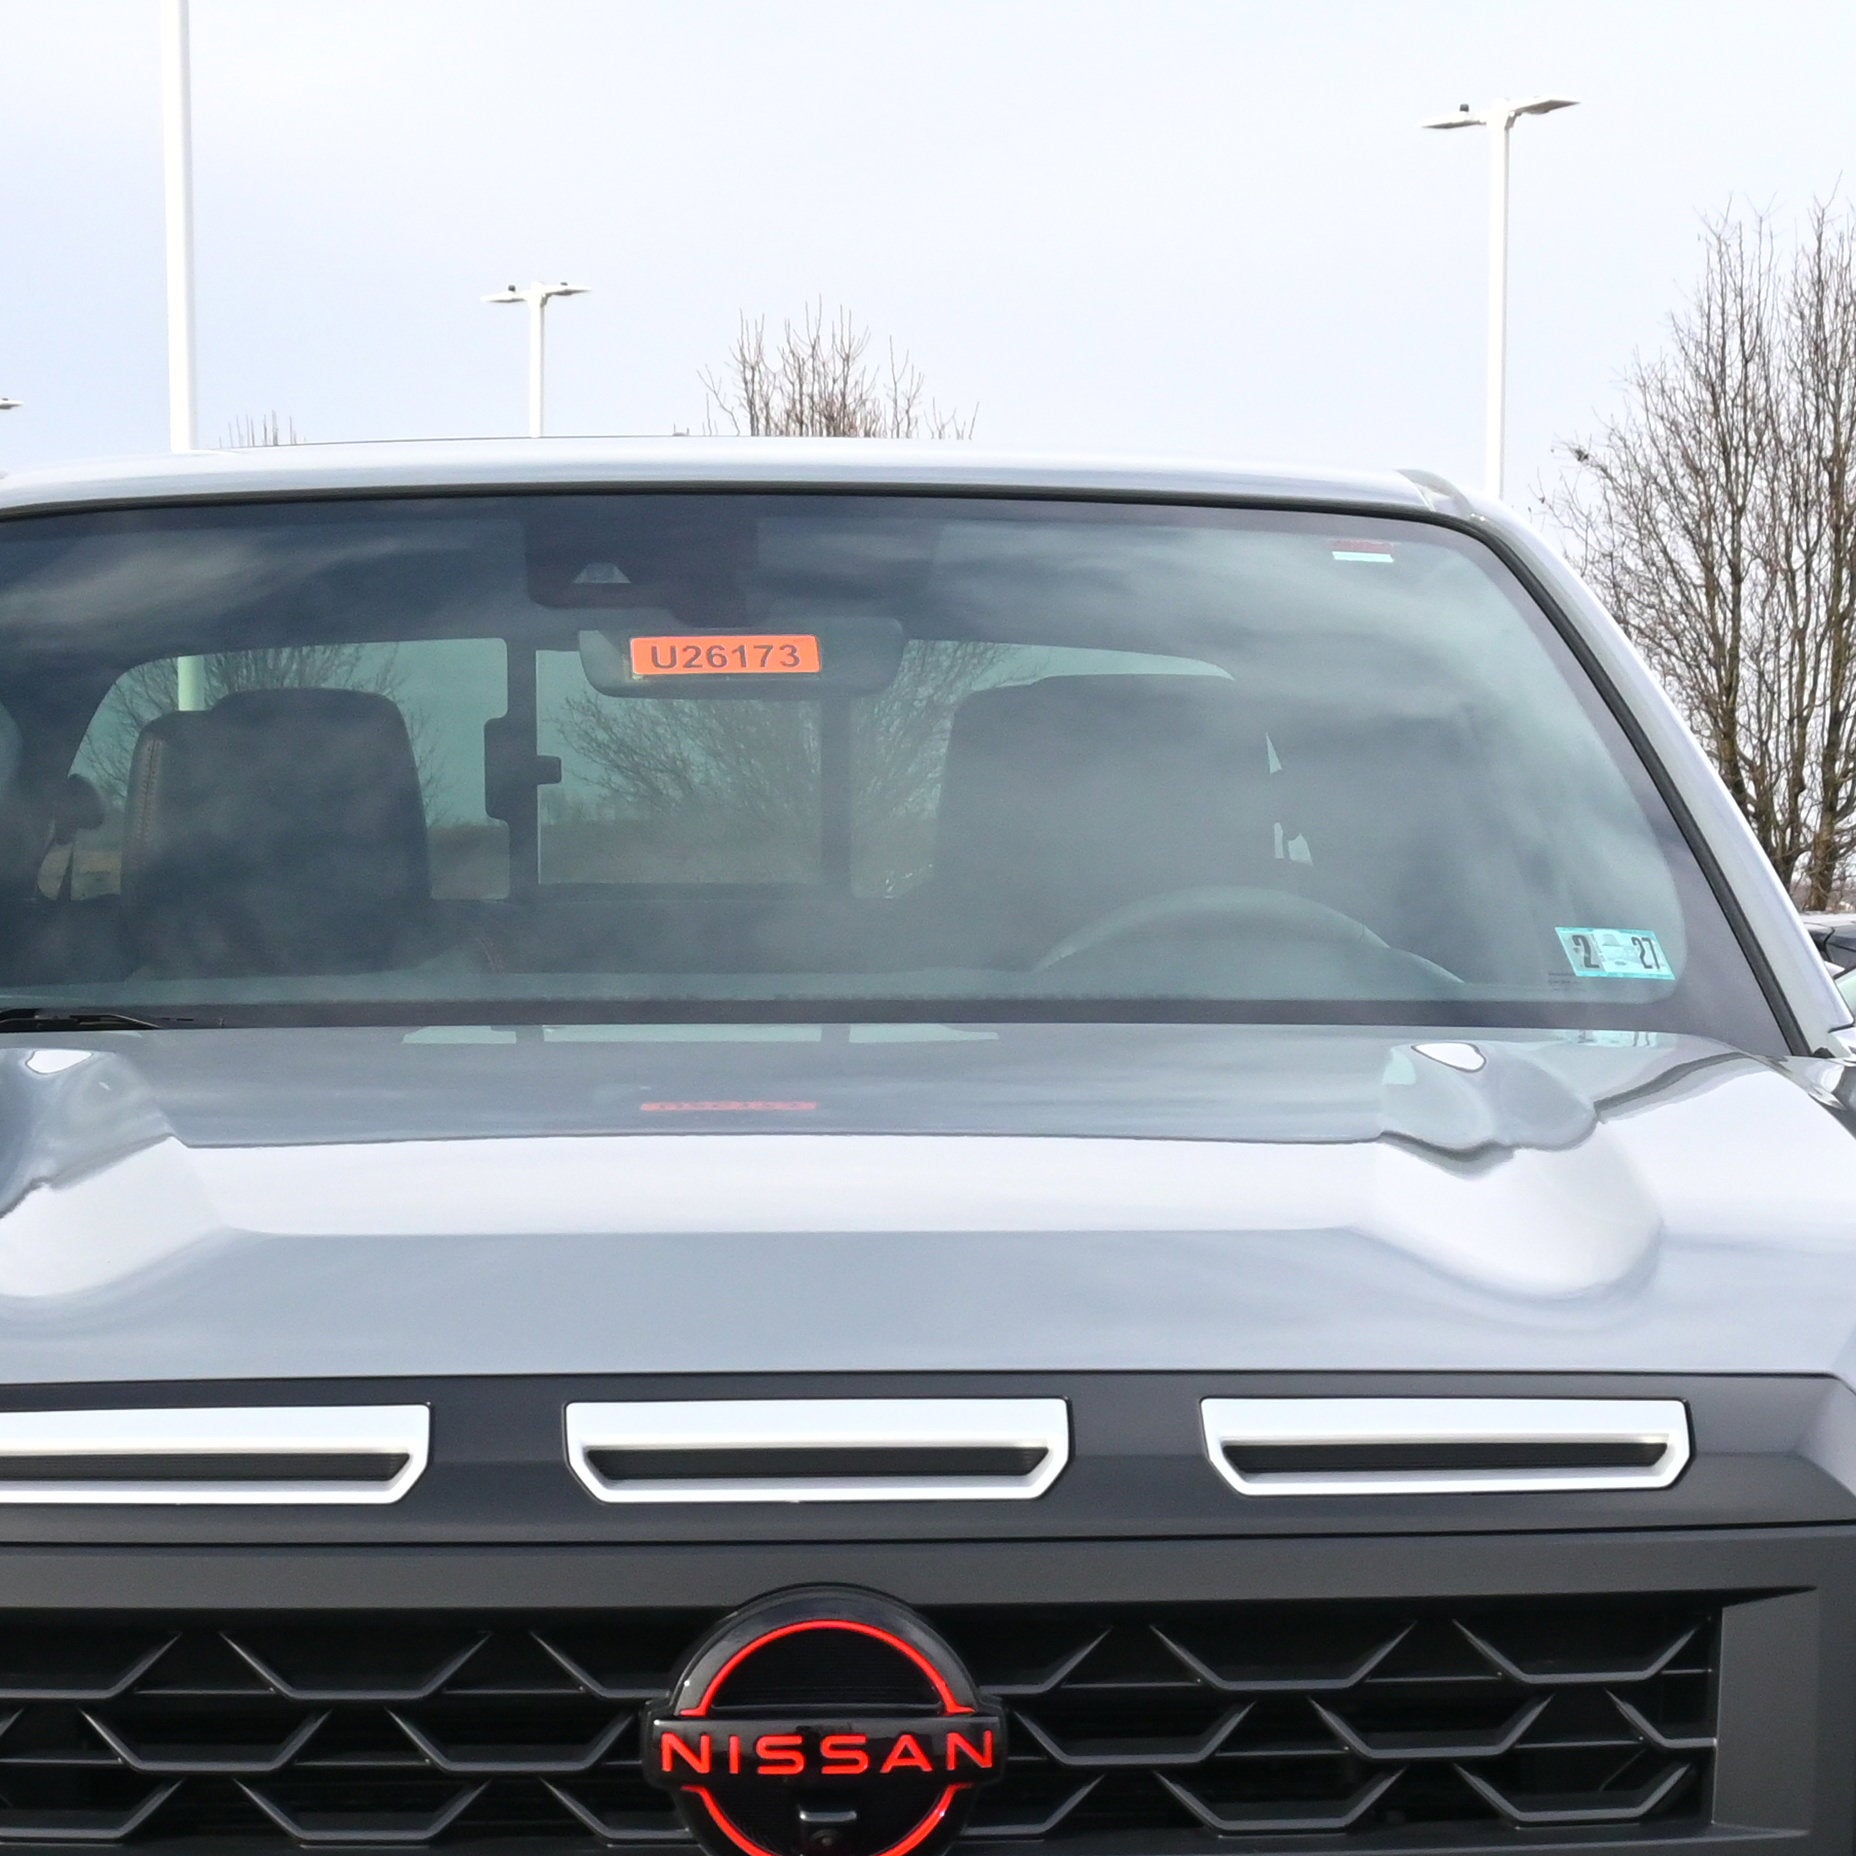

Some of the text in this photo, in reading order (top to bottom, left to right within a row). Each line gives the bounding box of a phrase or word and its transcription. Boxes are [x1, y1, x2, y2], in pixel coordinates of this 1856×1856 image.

[650, 643, 802, 670] U26173
[1571, 934, 1661, 970] 2 27
[659, 1729, 994, 1776] NISSAN
